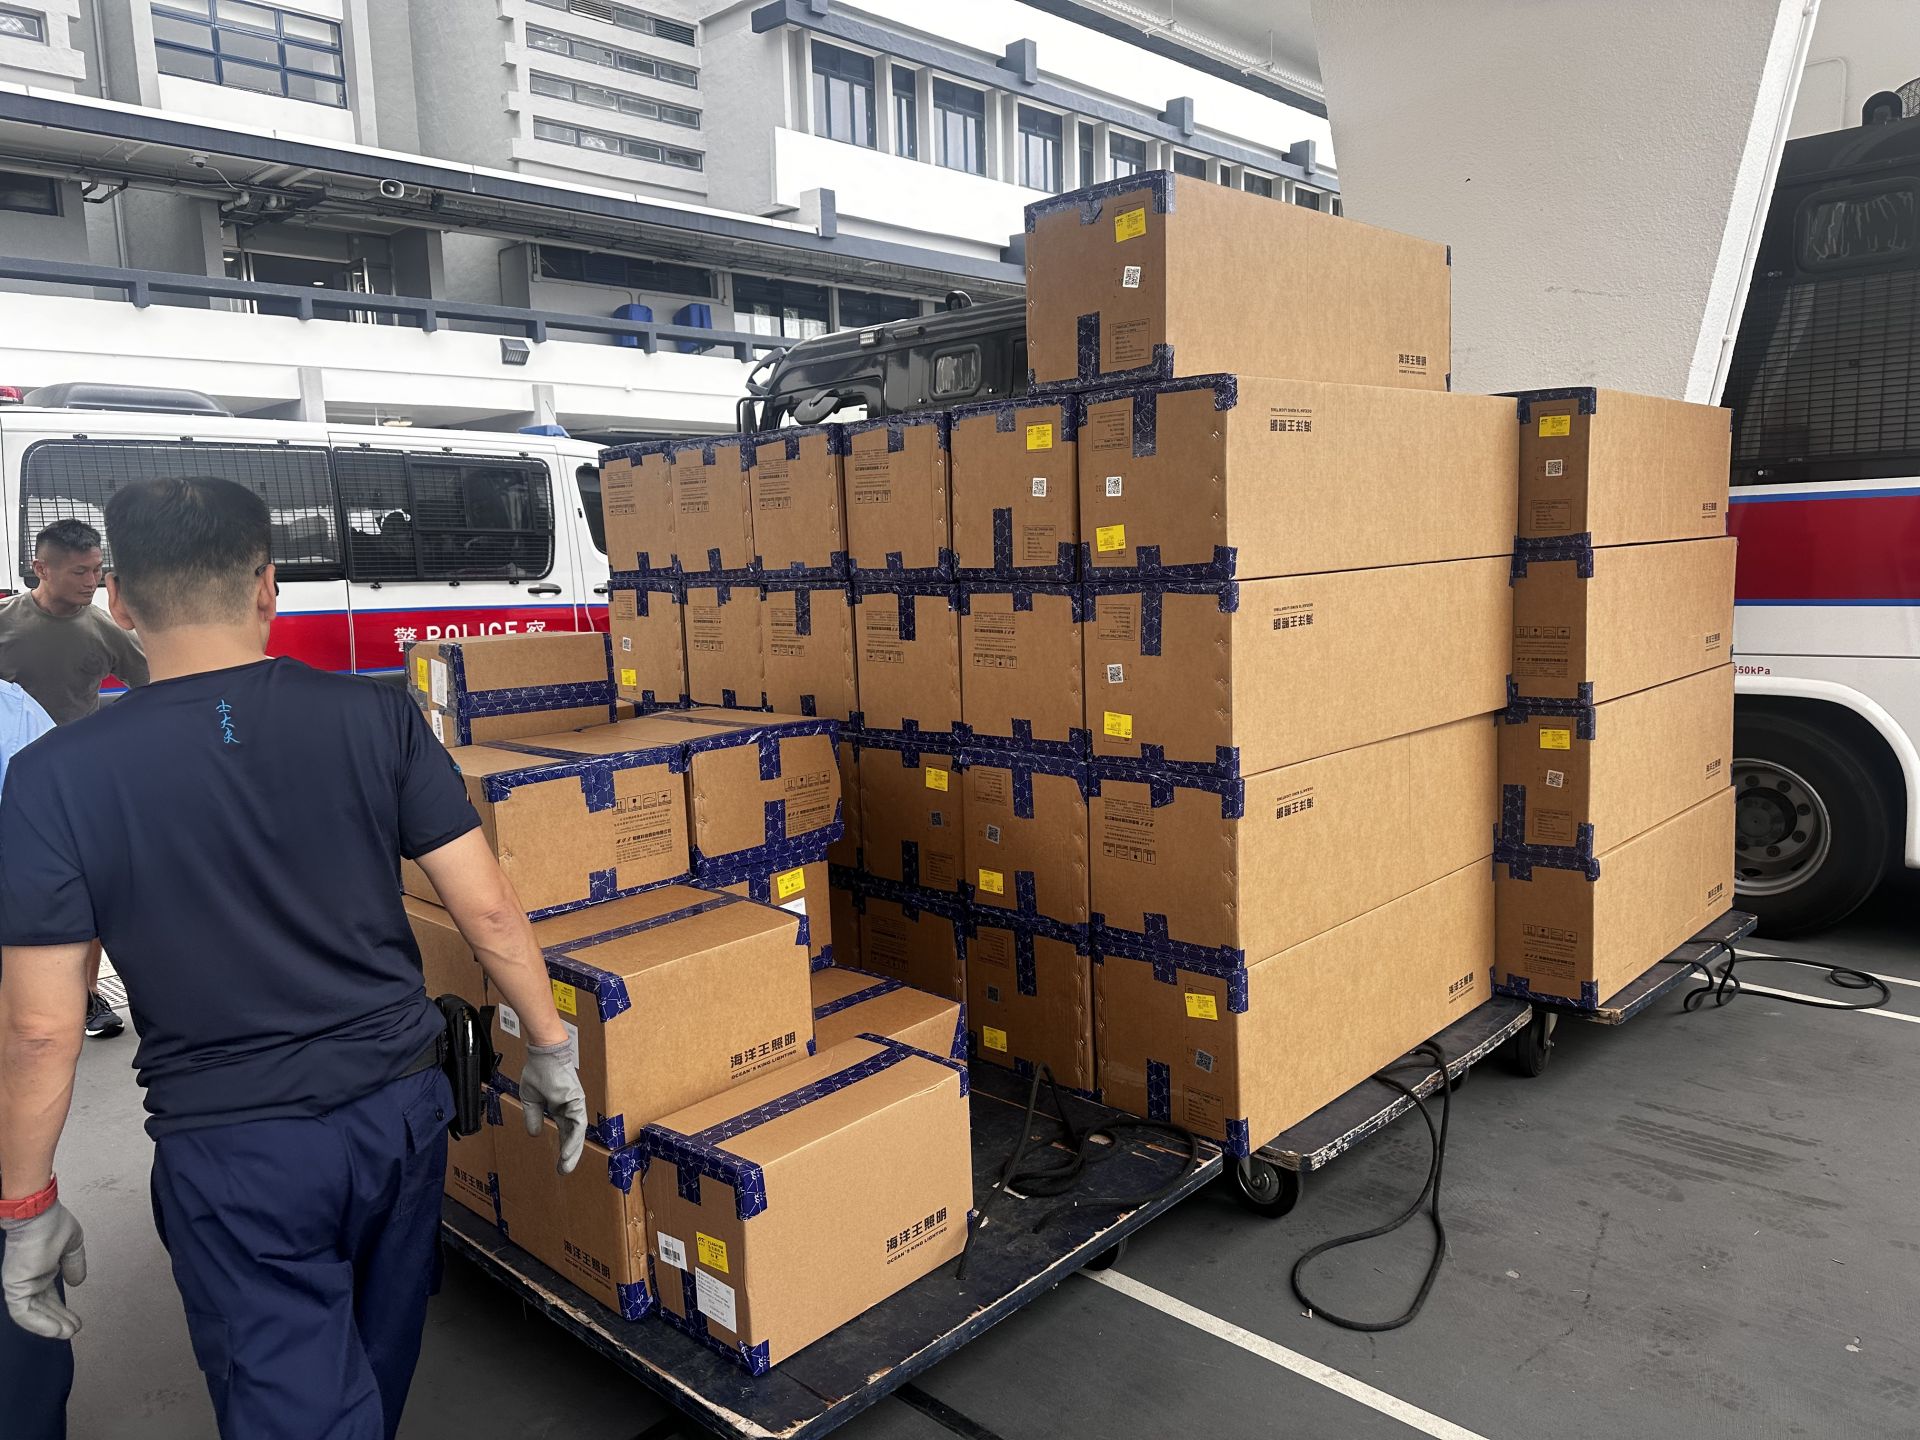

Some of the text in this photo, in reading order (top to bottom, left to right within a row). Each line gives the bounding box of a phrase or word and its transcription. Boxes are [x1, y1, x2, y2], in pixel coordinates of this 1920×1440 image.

[730, 1031, 796, 1069] 海洋王照明
[731, 1049, 797, 1079] OCEAN'S KING LIGHTING
[886, 1206, 947, 1253] 海洋王照明
[886, 1226, 948, 1265] OCEAN'S KING LIGHTING
